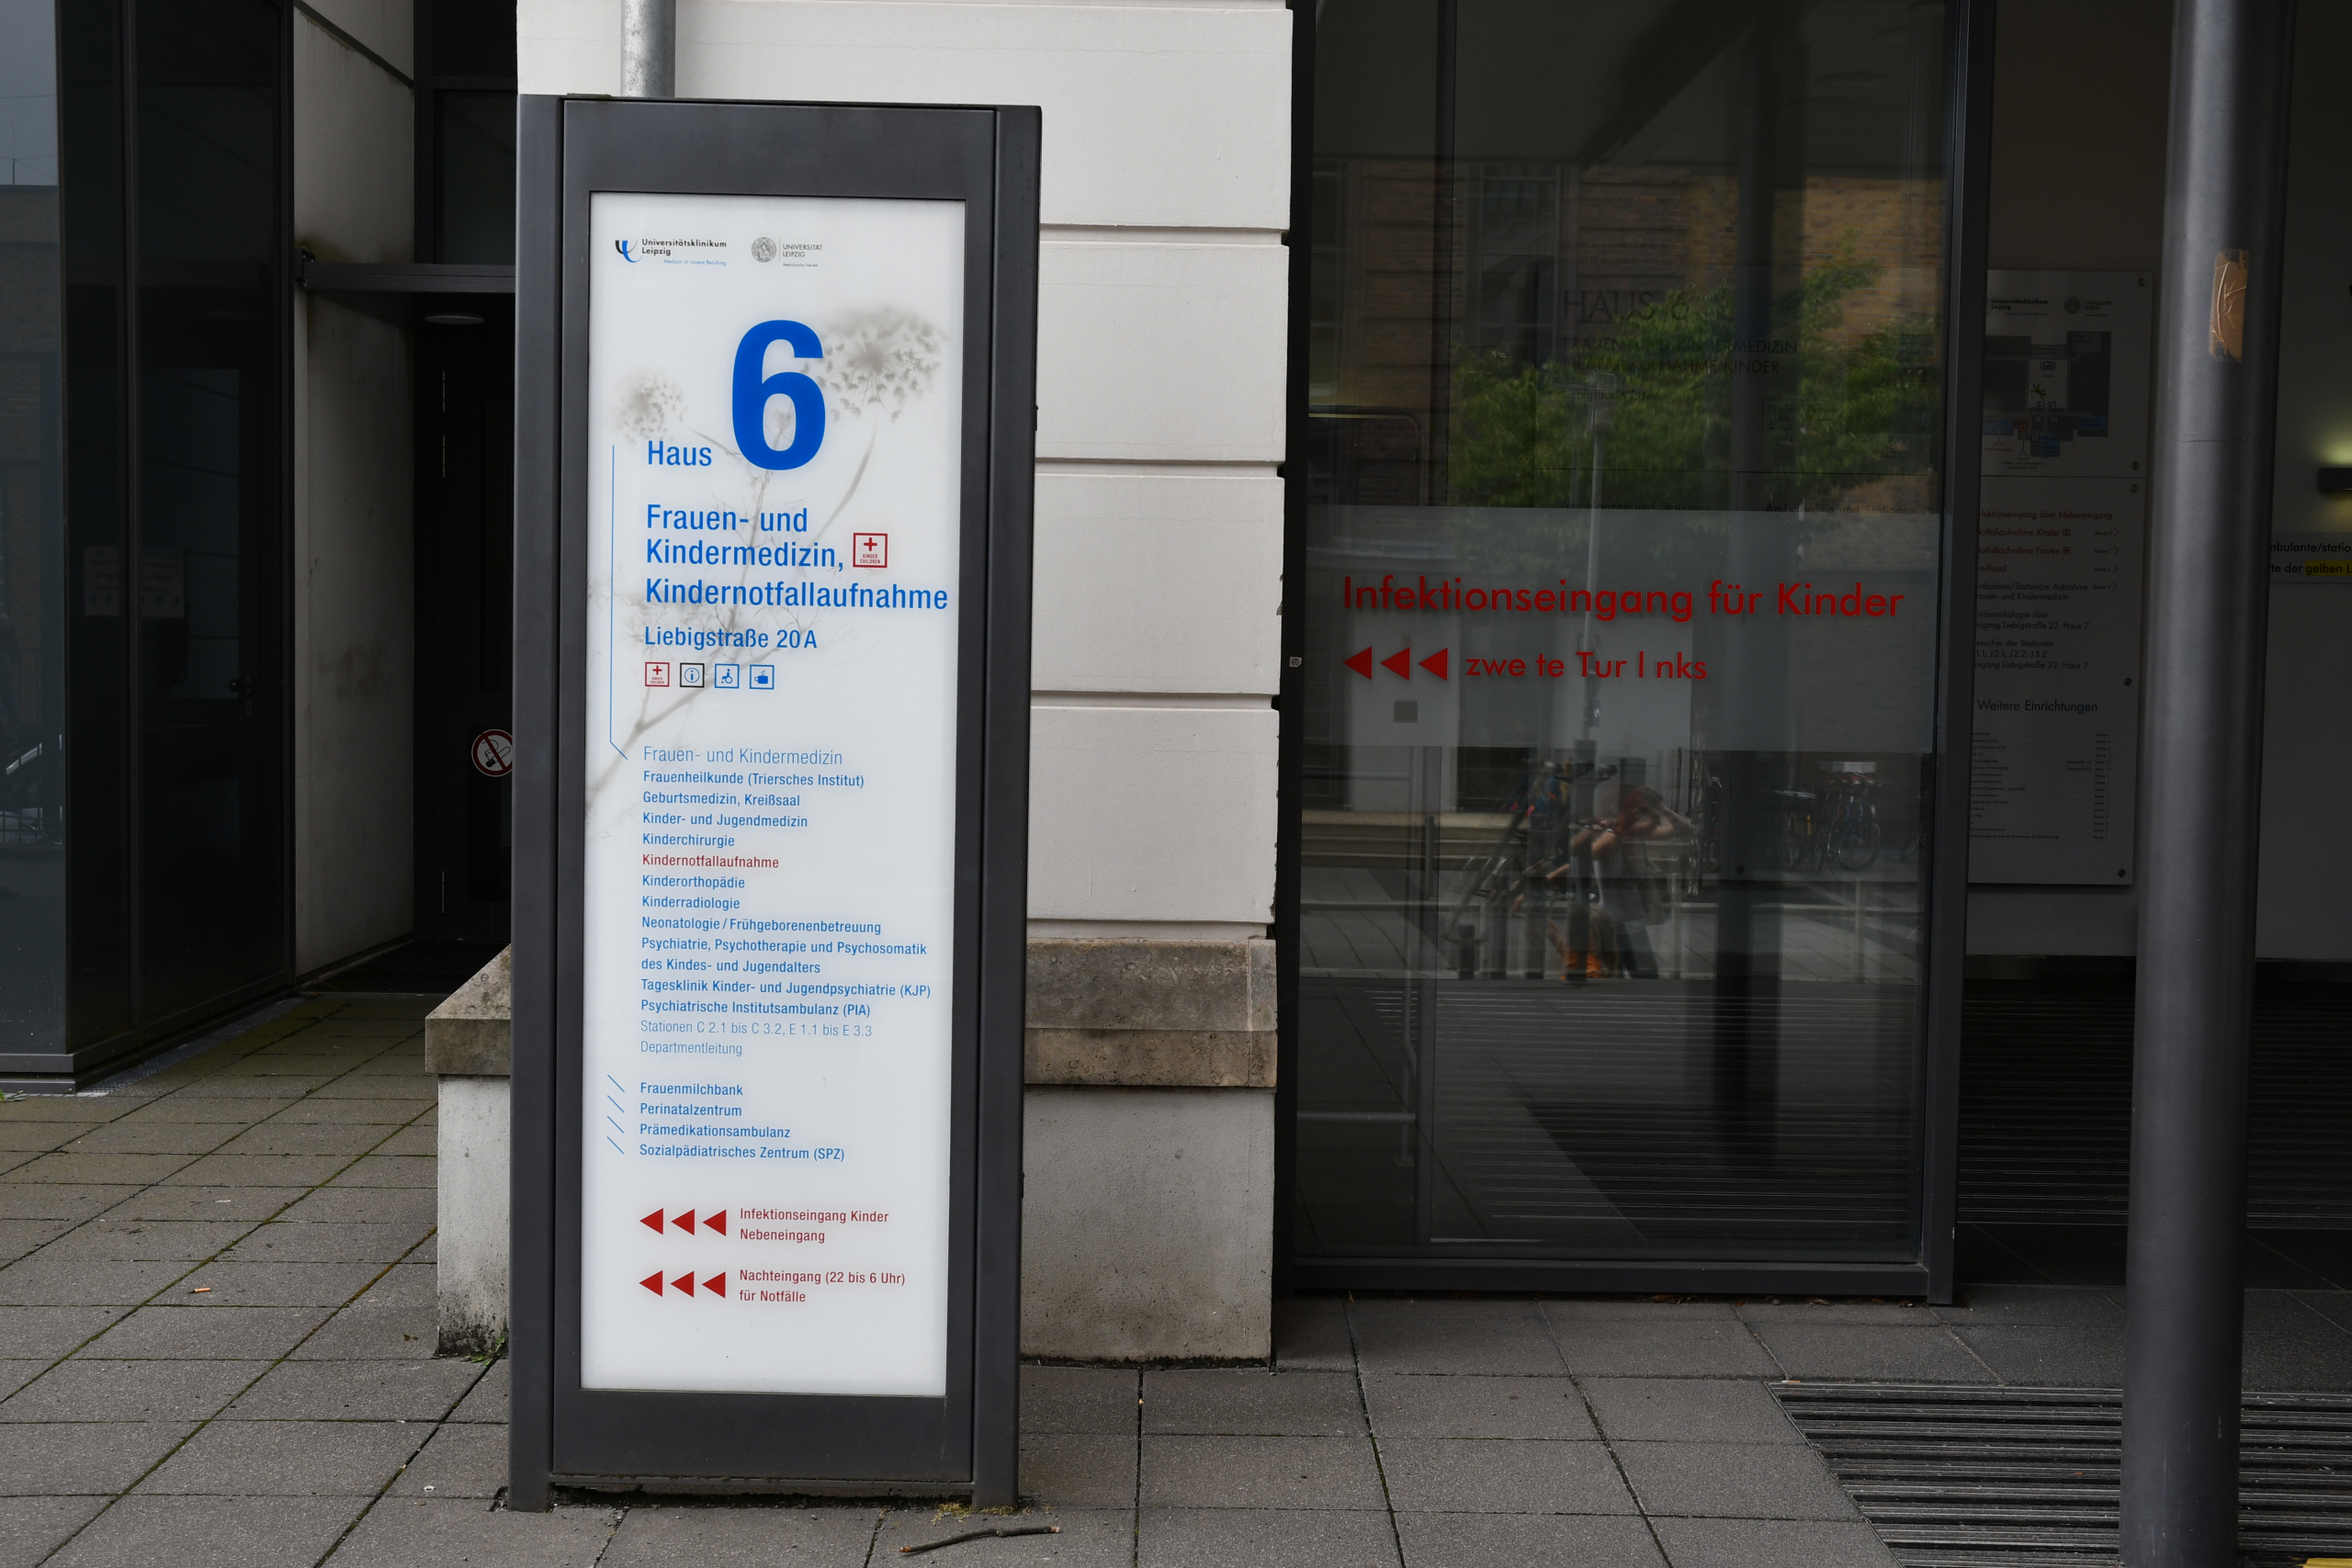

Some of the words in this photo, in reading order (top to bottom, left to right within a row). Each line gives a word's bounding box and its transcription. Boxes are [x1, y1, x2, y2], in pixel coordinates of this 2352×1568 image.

[642, 238, 727, 248] Universitätsklinikum
[642, 247, 671, 256] Leipzig
[1564, 289, 1655, 321] HAUS
[1724, 359, 1780, 374] KINDER
[648, 440, 712, 467] Haus
[732, 319, 826, 470] 6
[648, 504, 749, 530] Frauen-
[761, 508, 807, 532] und
[2058, 511, 2113, 521] Nebeneingang
[2036, 528, 2060, 536] Kinder
[648, 539, 842, 571] Kindermedizin,
[2036, 547, 2060, 555] Frauen
[2284, 562, 2303, 573] der
[2305, 563, 2343, 576] gelben
[647, 579, 947, 609] Kindernotfallaufnahme
[2052, 583, 2088, 592] Aufnahme
[1345, 575, 1692, 623] Infektionseingang
[1708, 580, 1763, 615] für
[1779, 582, 1904, 616] Kinder
[2001, 592, 2015, 601] und
[2017, 592, 2069, 601] Kindermedizin
[2032, 610, 2049, 618] über
[2003, 621, 2047, 631] Liebigstraße
[2048, 622, 2060, 630] 22,
[2063, 622, 2082, 630] Haus
[645, 626, 768, 650] Liebigstraße
[2006, 638, 2018, 647] der
[2020, 639, 2053, 648] Stationen
[2002, 660, 2045, 671] Liebigstraße
[2048, 661, 2060, 670] 22,
[1977, 699, 2020, 711] Weitere
[2025, 699, 2098, 715] Einrichtungen
[644, 746, 700, 761] Frauen-
[707, 749, 733, 762] und
[741, 749, 842, 764] Kindermedizin
[644, 771, 743, 784] Frauenheilkunde
[749, 773, 813, 786] (Triersches
[819, 774, 864, 788] Institut)
[643, 791, 740, 807] Geburtsmedizin,
[745, 794, 799, 806] Kreißsaal
[643, 812, 685, 824] Kinder-
[691, 814, 712, 825] und
[717, 814, 807, 828] Jugendmedizin
[643, 833, 734, 849] Kinderchirurgie
[643, 854, 778, 868] Kindernotfallaufnahme
[643, 875, 744, 890] Kinderorthopädie
[643, 896, 740, 911] Kinderradiologie
[642, 937, 710, 952] Psychiatrie,
[716, 939, 806, 953] Psychotherapie
[811, 942, 832, 953] und
[838, 942, 926, 955] Psychosomatik
[641, 958, 662, 969] des
[667, 959, 711, 970] Kindes-
[717, 961, 738, 971] und
[743, 961, 820, 974] Jugendalters
[641, 979, 707, 992] Tagesklinik
[713, 981, 755, 992] Kinder-
[761, 982, 781, 993] und
[786, 982, 895, 997] Jugendpsychiatrie
[900, 985, 930, 998] (KJP)
[642, 999, 728, 1013] Psychiatrische
[733, 1002, 838, 1015] Institutsambulanz
[843, 1004, 870, 1018] (PIA)
[641, 1021, 692, 1032] Stationen
[697, 1021, 704, 1032] C
[709, 1022, 725, 1032] 2.1
[732, 1022, 747, 1033] bis
[752, 1022, 759, 1033] C
[763, 1023, 785, 1035] 3.2,
[790, 1023, 796, 1034] E
[801, 1024, 816, 1034] 1.1
[823, 1024, 838, 1035] bis
[843, 1025, 849, 1035] E
[854, 1025, 872, 1036] 3.3
[641, 1041, 741, 1056] Departmentleitung
[641, 1082, 742, 1095] Frauenmilchbank
[641, 1103, 741, 1116] Perinatalzentrum
[640, 1123, 790, 1137] Prämedikationsambulanz
[640, 1145, 755, 1158] Sozialpädiatrisches
[760, 1147, 808, 1158] Zentrum
[814, 1148, 844, 1162] (SPZ)
[741, 1208, 846, 1224] Infektionseingang
[852, 1211, 888, 1222] Kinder
[741, 1229, 824, 1244] Nebeneingang
[741, 1269, 820, 1284] Nachteingang
[826, 1271, 843, 1284] (22
[849, 1272, 865, 1283] bis
[870, 1272, 876, 1283] 6
[881, 1273, 905, 1286] Uhr)
[740, 1290, 756, 1301] für
[761, 1291, 805, 1302] Notfälle
